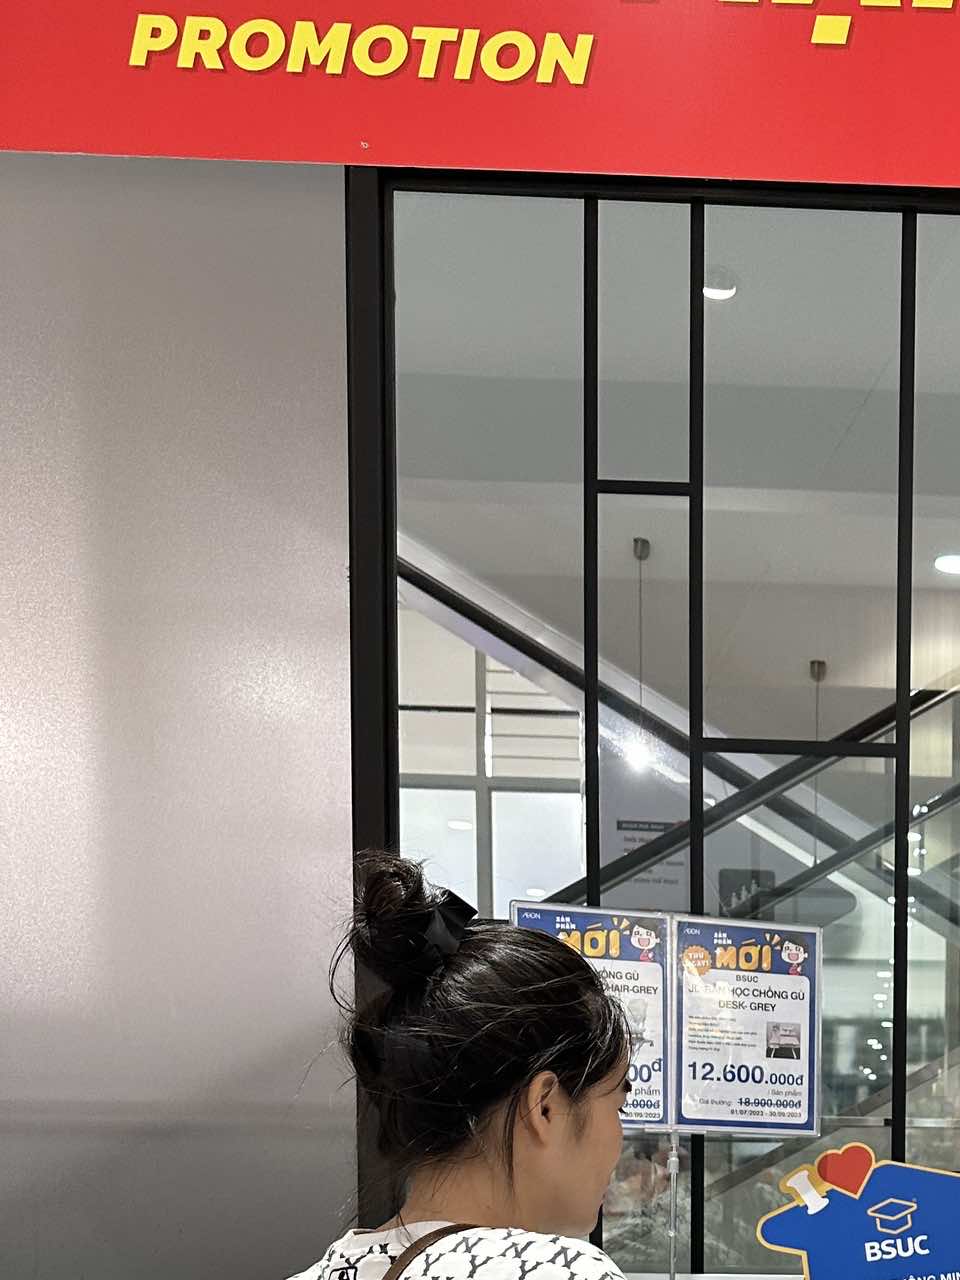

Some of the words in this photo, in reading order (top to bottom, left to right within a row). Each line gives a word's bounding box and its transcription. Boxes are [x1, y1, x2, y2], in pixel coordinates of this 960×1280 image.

[128, 13, 594, 85] PROMOTION
[715, 938, 772, 972] MỚI
[752, 985, 789, 1000] CHỐNG
[749, 1002, 777, 1012] GREY
[688, 1061, 804, 1086] 12.600.000đ
[864, 1234, 930, 1262] BSUC
